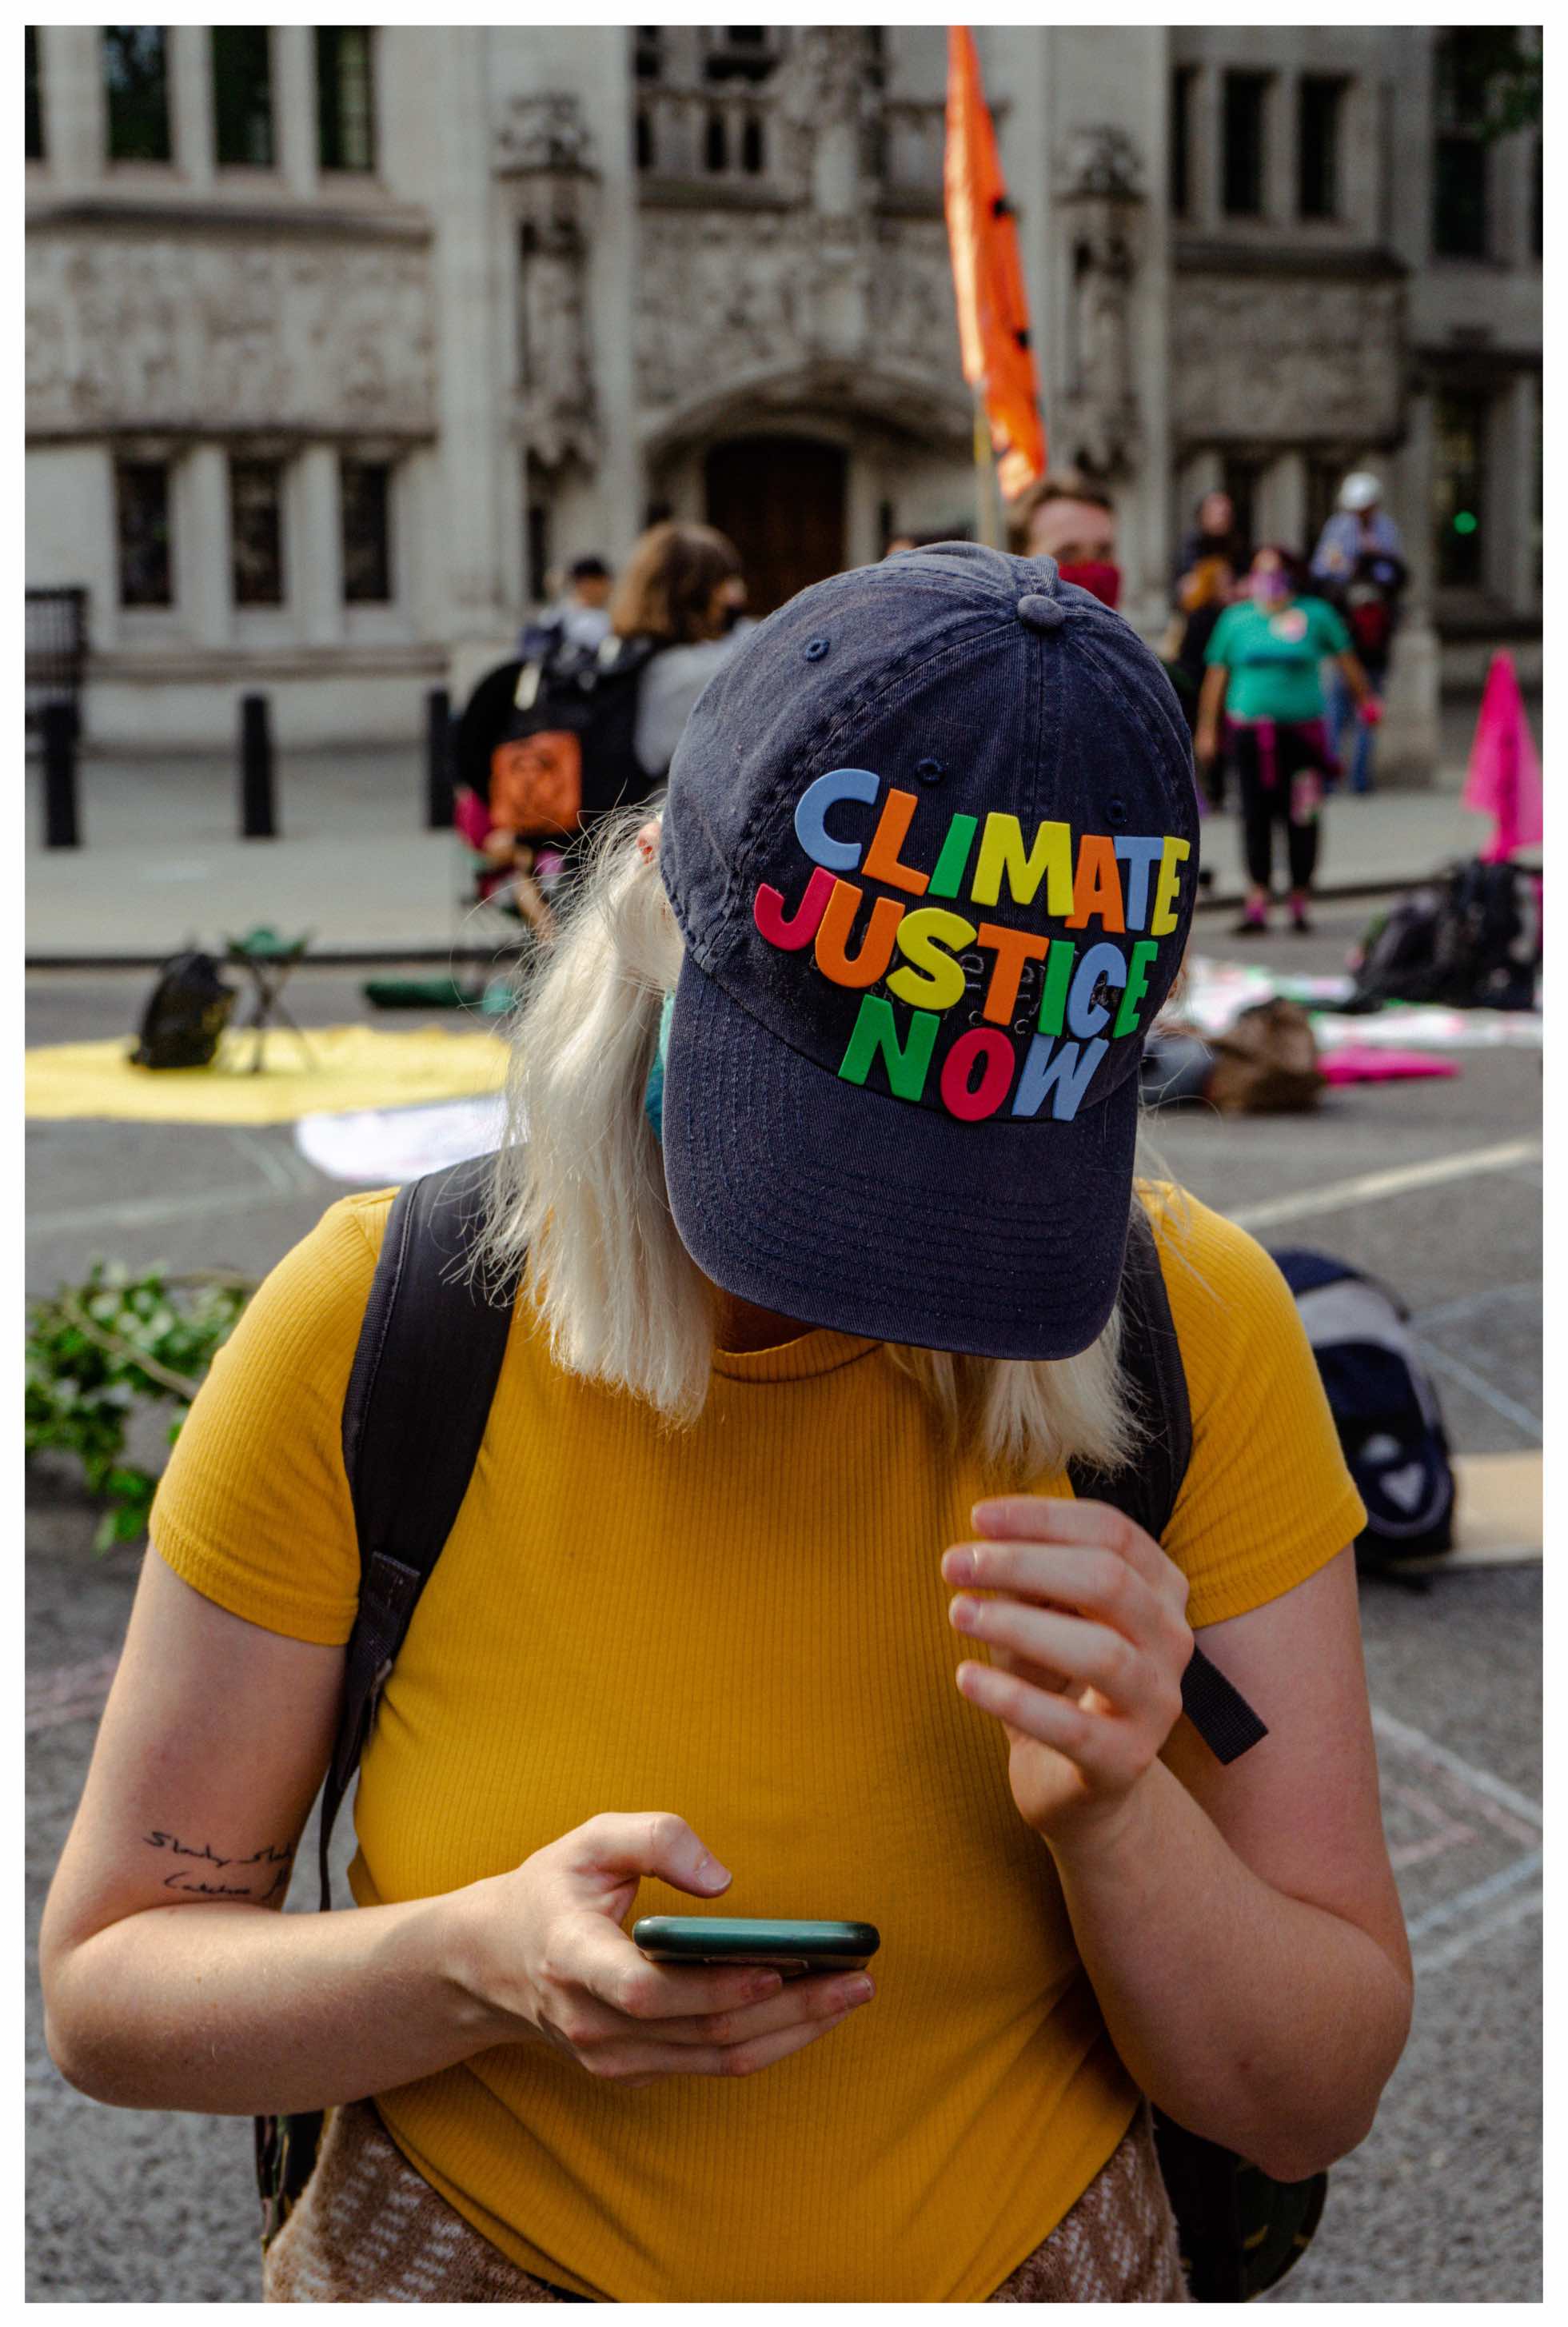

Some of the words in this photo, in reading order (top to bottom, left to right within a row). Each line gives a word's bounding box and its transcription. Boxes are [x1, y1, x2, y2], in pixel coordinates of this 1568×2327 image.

[795, 768, 1190, 936] CLIMATE
[754, 867, 1158, 1039] JUSTICE
[837, 994, 1108, 1121] NOW
